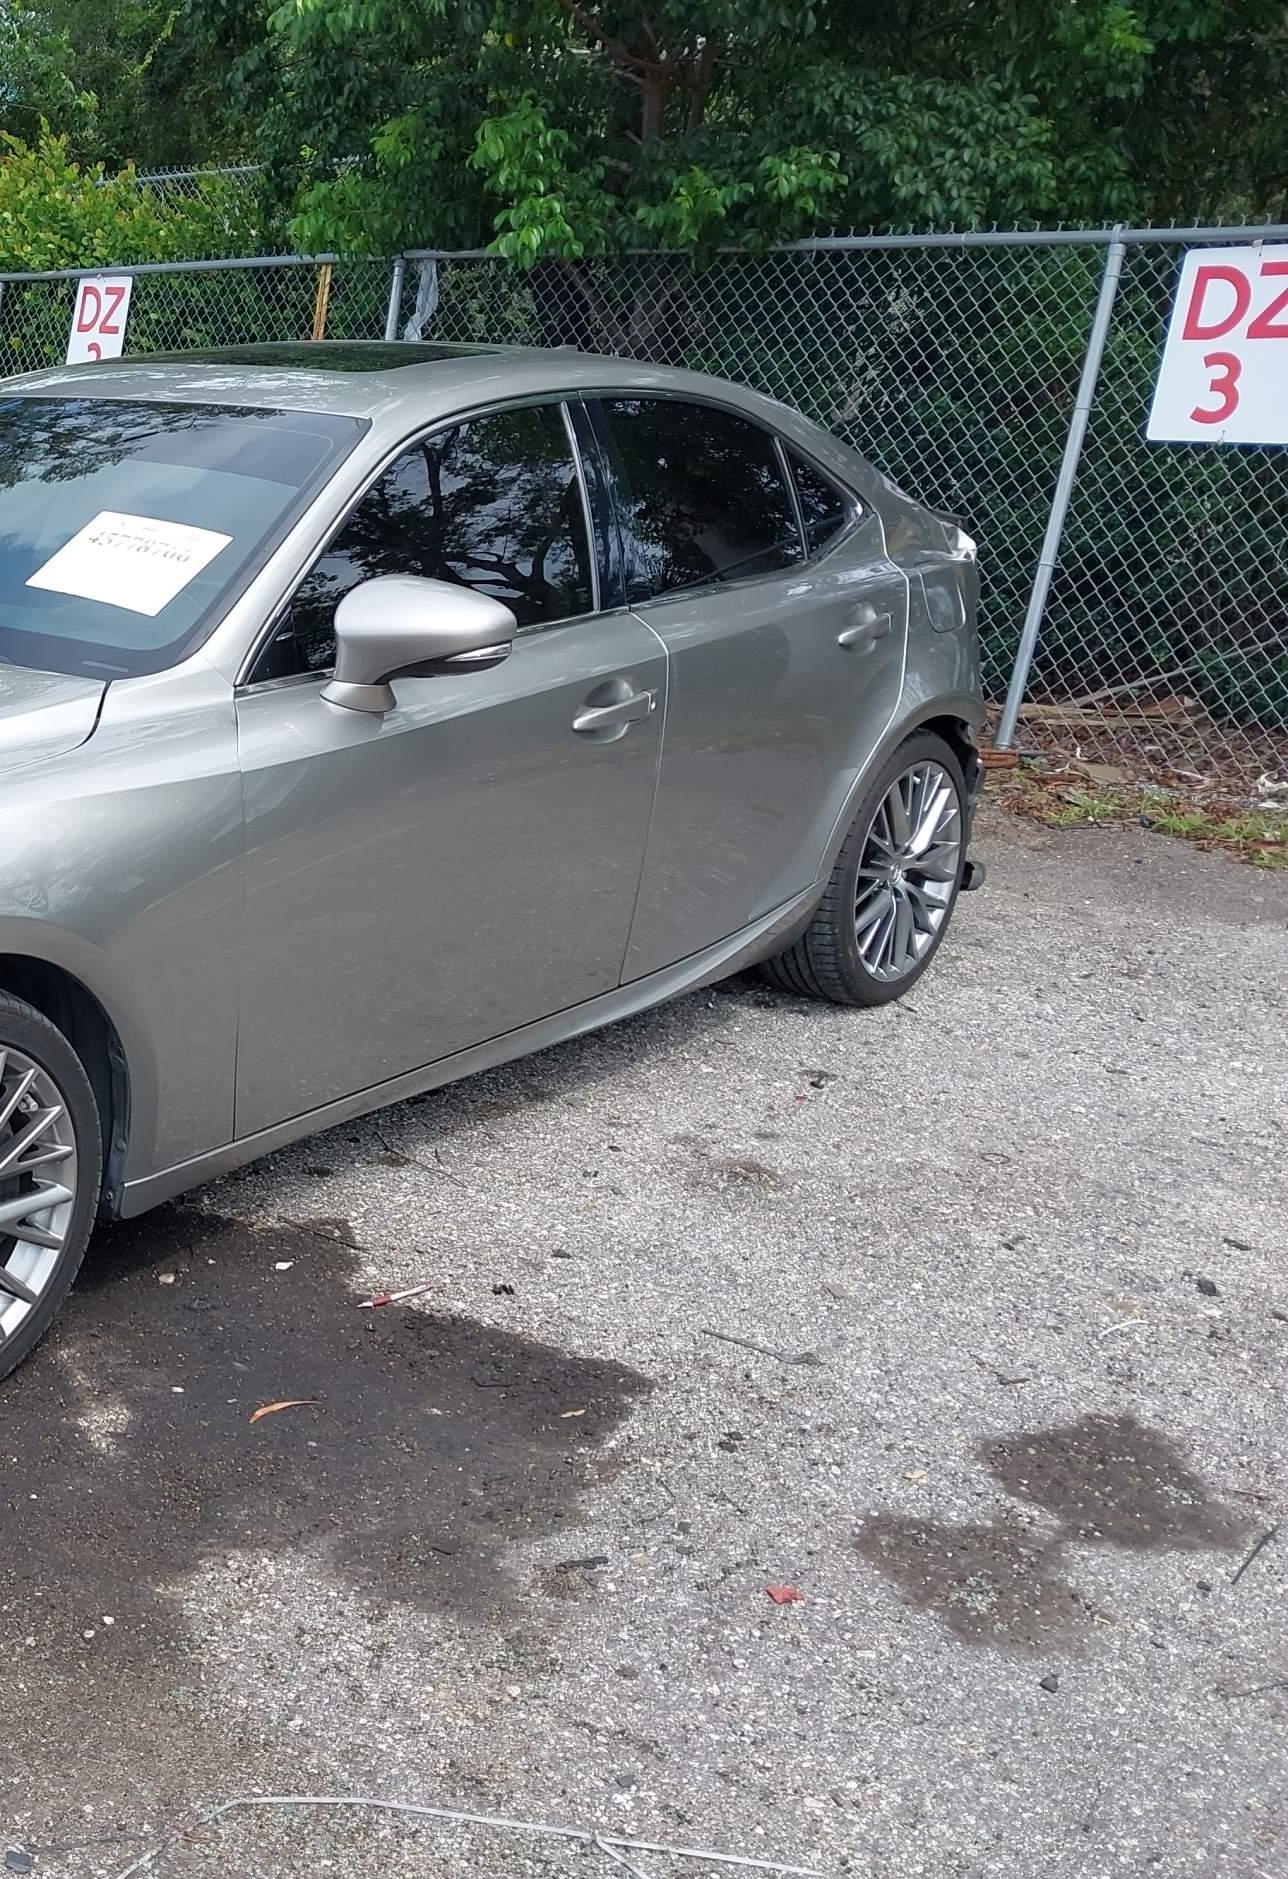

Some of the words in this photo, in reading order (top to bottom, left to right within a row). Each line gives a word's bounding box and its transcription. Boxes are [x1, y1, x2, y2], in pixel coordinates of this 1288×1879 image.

[77, 286, 126, 334] DZ
[1182, 261, 1288, 340] DZ
[1190, 351, 1242, 424] 3
